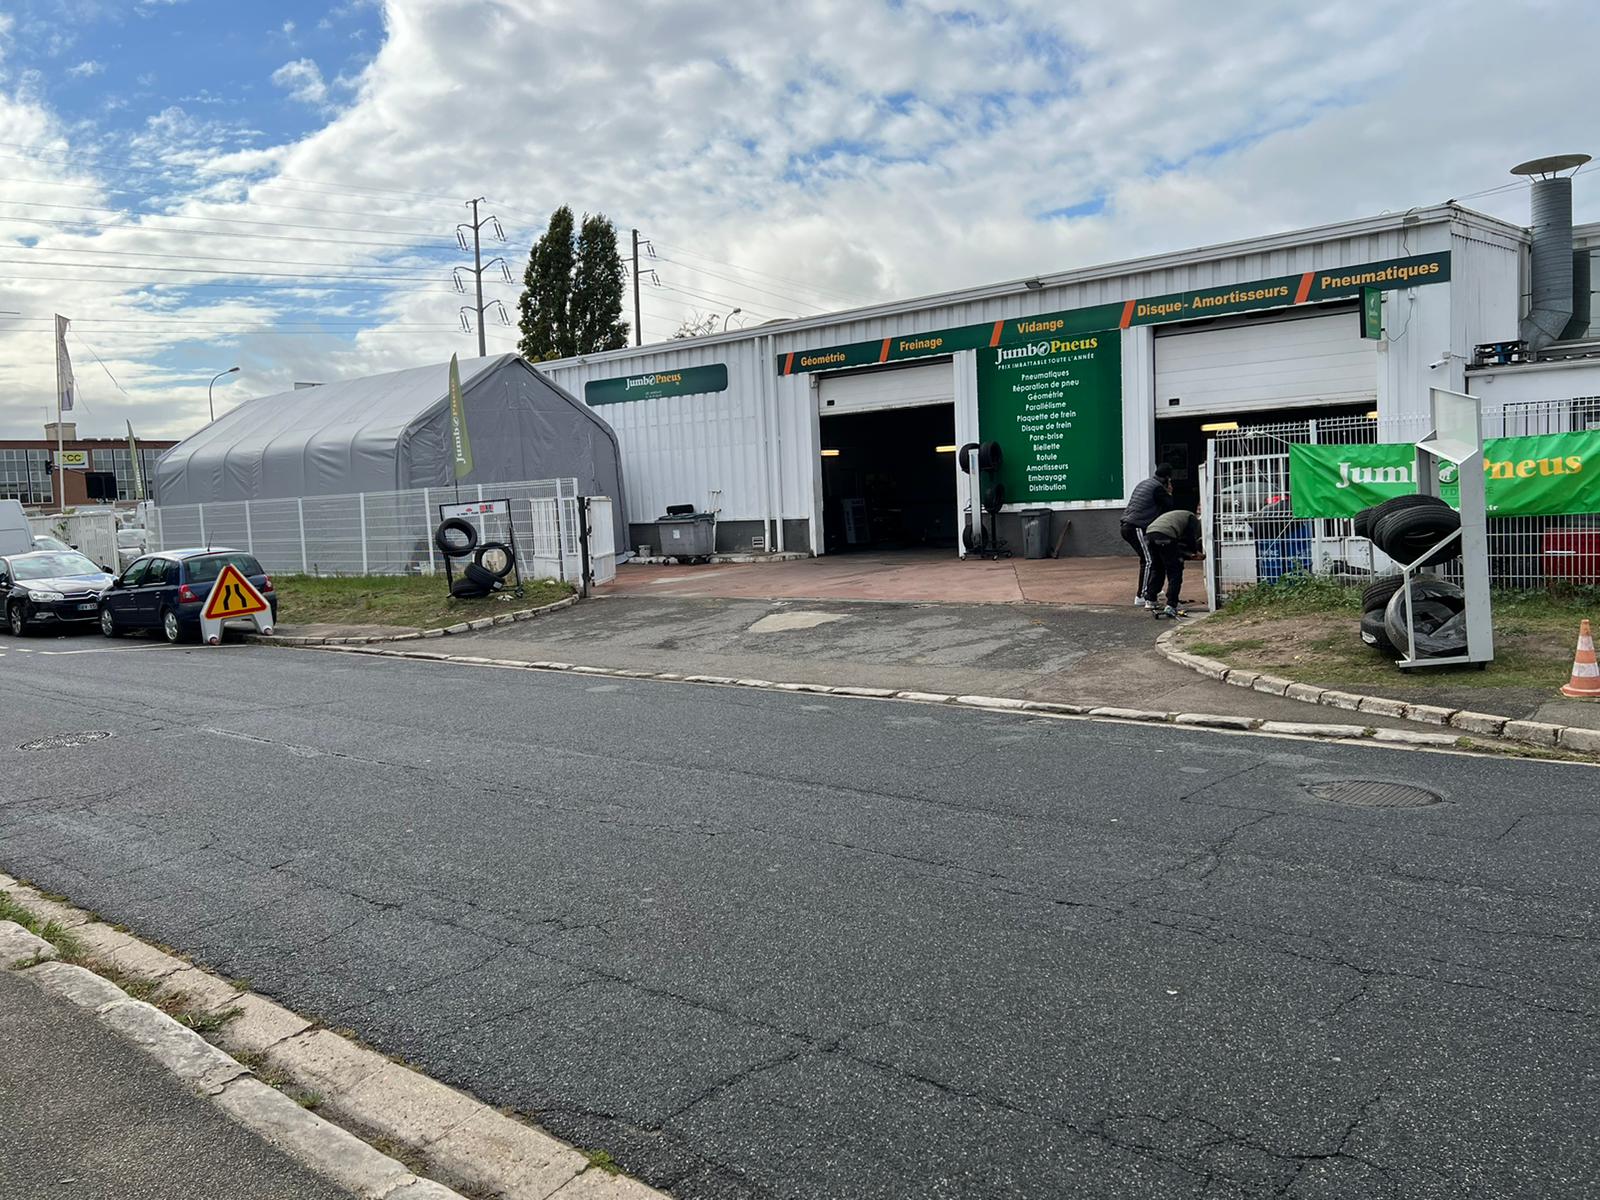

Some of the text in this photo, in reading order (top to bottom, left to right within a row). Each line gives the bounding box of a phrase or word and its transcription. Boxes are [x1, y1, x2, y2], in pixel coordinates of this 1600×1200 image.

[1321, 260, 1440, 290] Pneumatiques
[1192, 285, 1289, 309] Amortisseurs
[1017, 318, 1064, 334] Vidange
[899, 336, 943, 351] Freinage
[800, 352, 846, 367] Géométrie
[1012, 359, 1047, 369] IMBATTABLE
[1021, 369, 1070, 381] Pneumatiques
[1012, 381, 1049, 393] Réparation
[1061, 380, 1080, 389] pneu
[1027, 390, 1064, 401] Géométrie
[1025, 400, 1067, 411] Parallélisme
[1016, 413, 1048, 423] Plaquette
[1060, 410, 1077, 418] frein
[1021, 424, 1044, 432] Disque
[1056, 421, 1072, 429] frein
[1029, 432, 1064, 442] Pare-brise
[1033, 443, 1061, 451] Biellette
[1036, 453, 1058, 461] Rotule
[1026, 463, 1069, 472] Amortisseurs
[1028, 473, 1067, 482] Embrayage
[1029, 483, 1067, 492] Distribution
